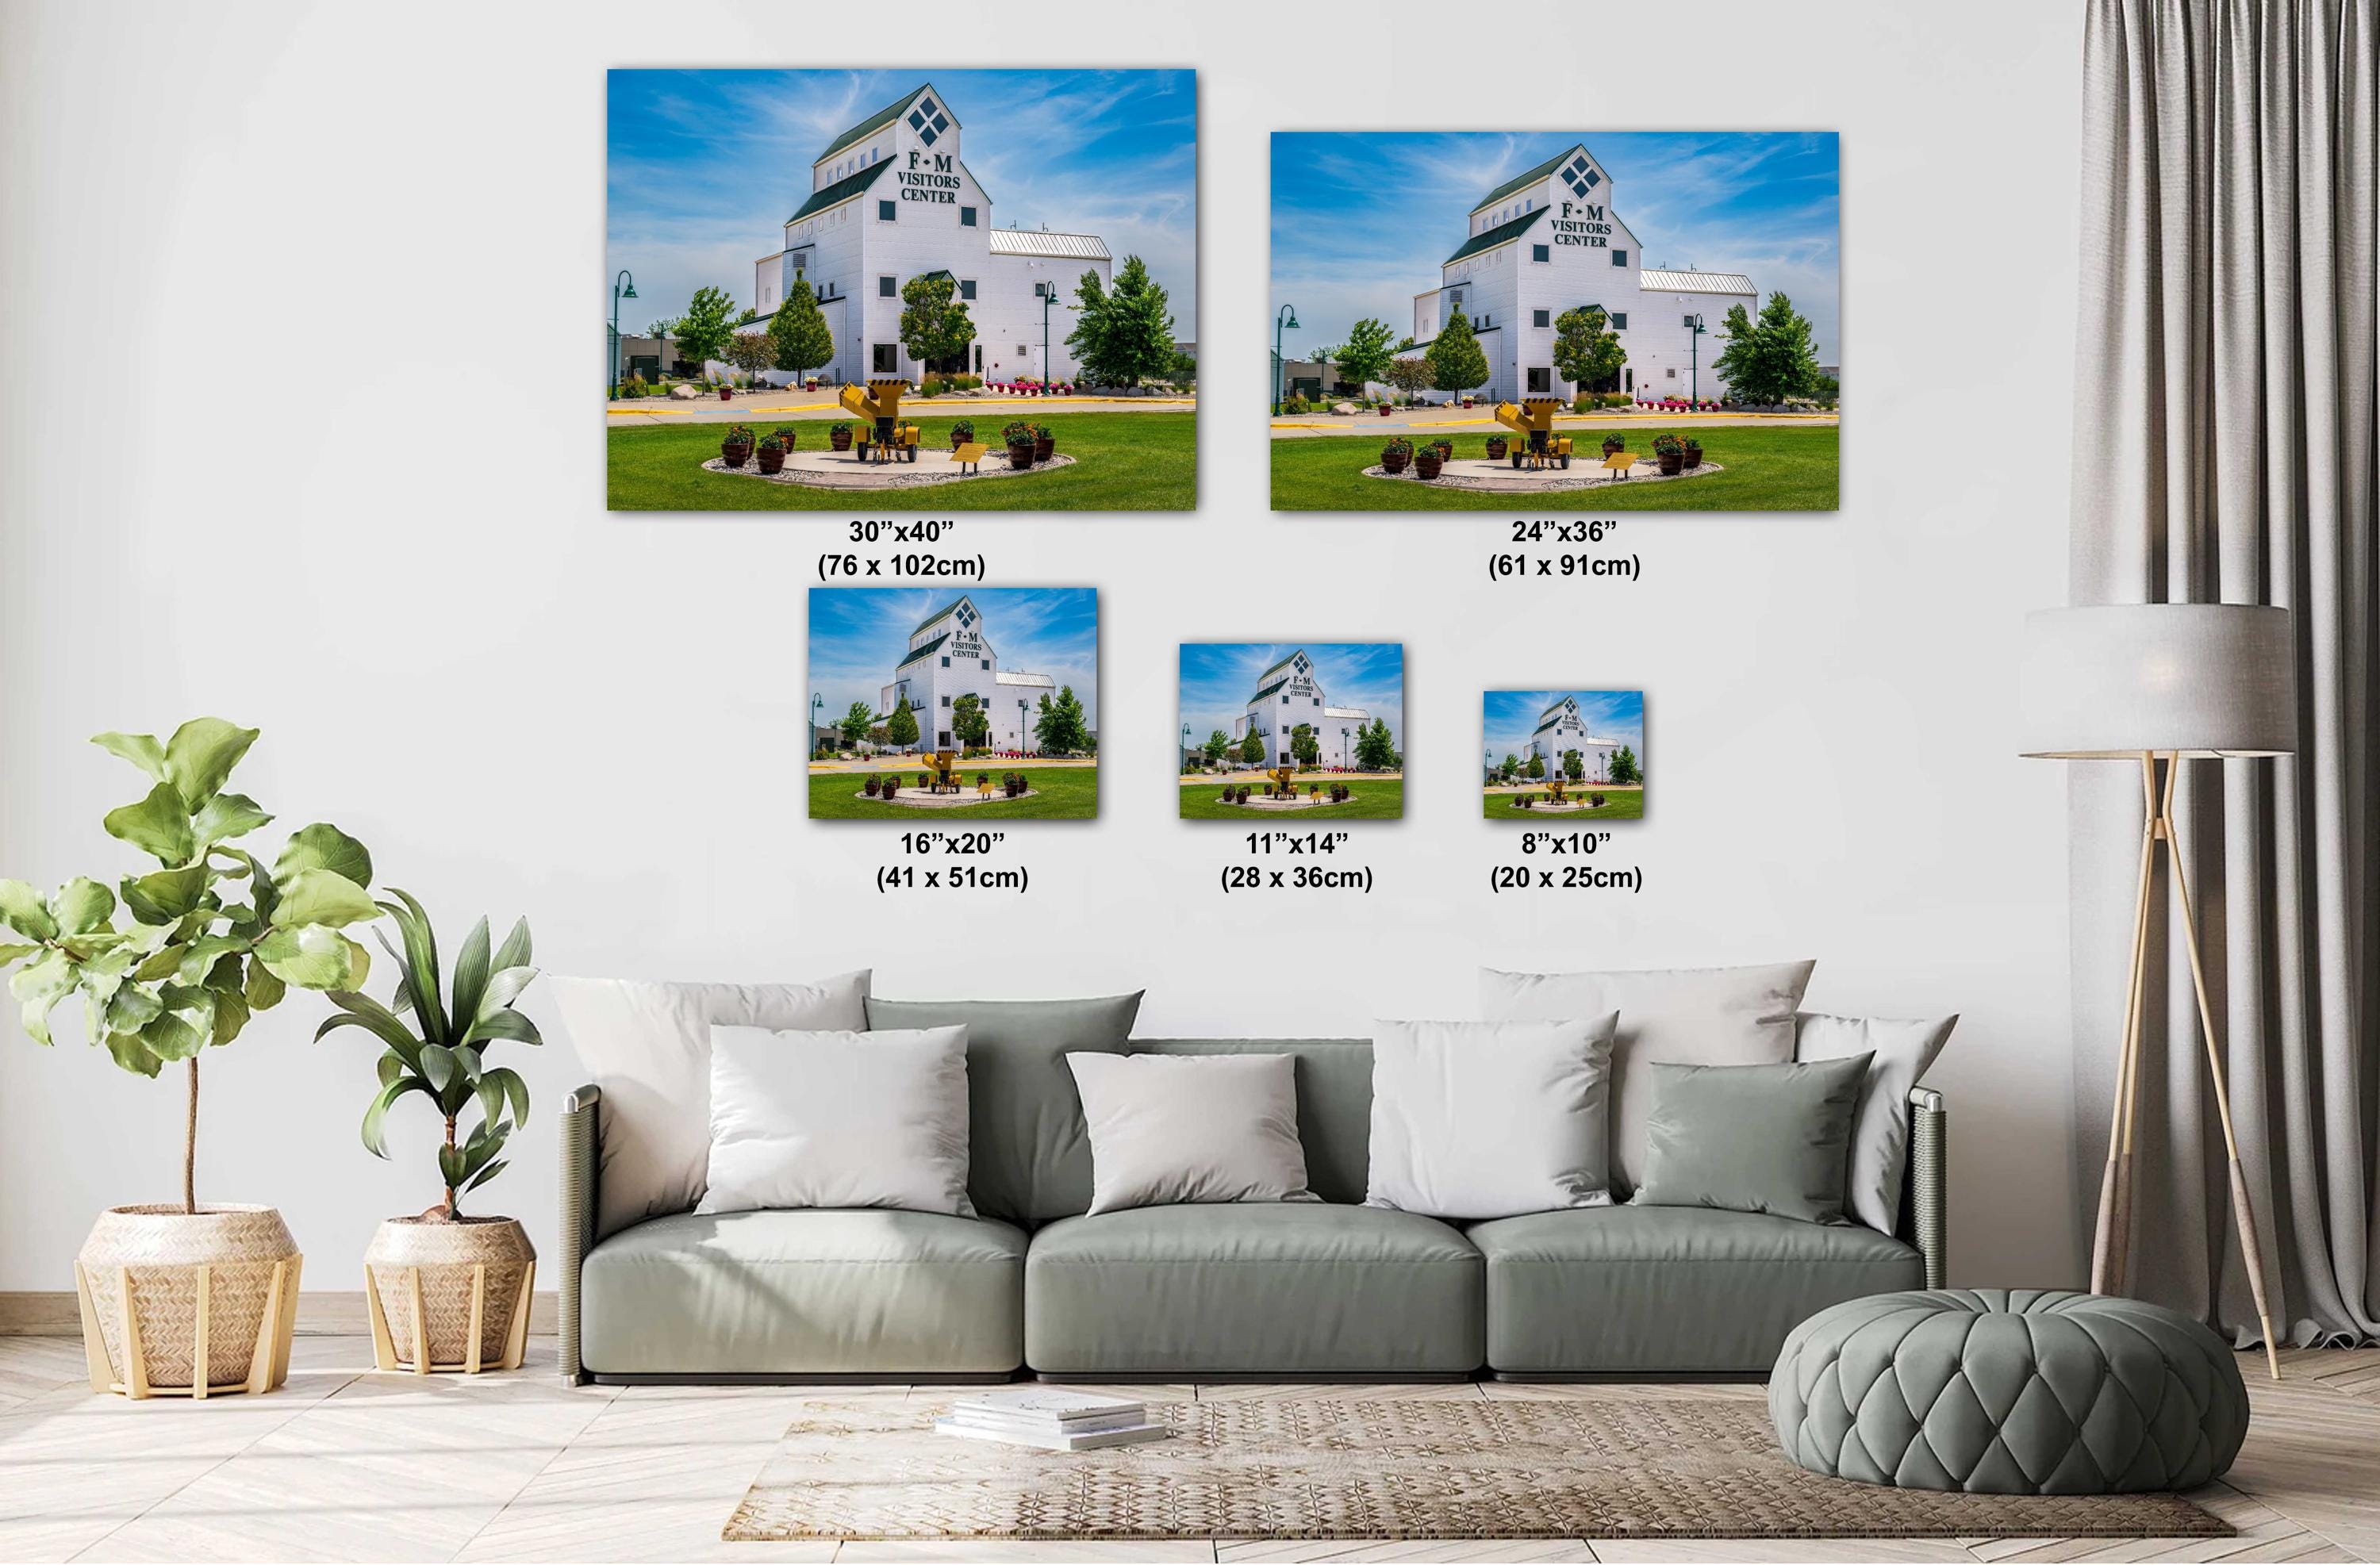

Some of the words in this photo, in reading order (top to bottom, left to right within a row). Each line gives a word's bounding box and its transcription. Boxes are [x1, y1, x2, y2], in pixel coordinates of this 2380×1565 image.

[897, 171, 960, 189] VISITORS
[901, 188, 956, 204] CENTER
[1551, 220, 1611, 235] VISITORS
[1554, 234, 1607, 247] CENTER
[950, 641, 982, 650] VISITORS
[952, 650, 980, 658] CENTER
